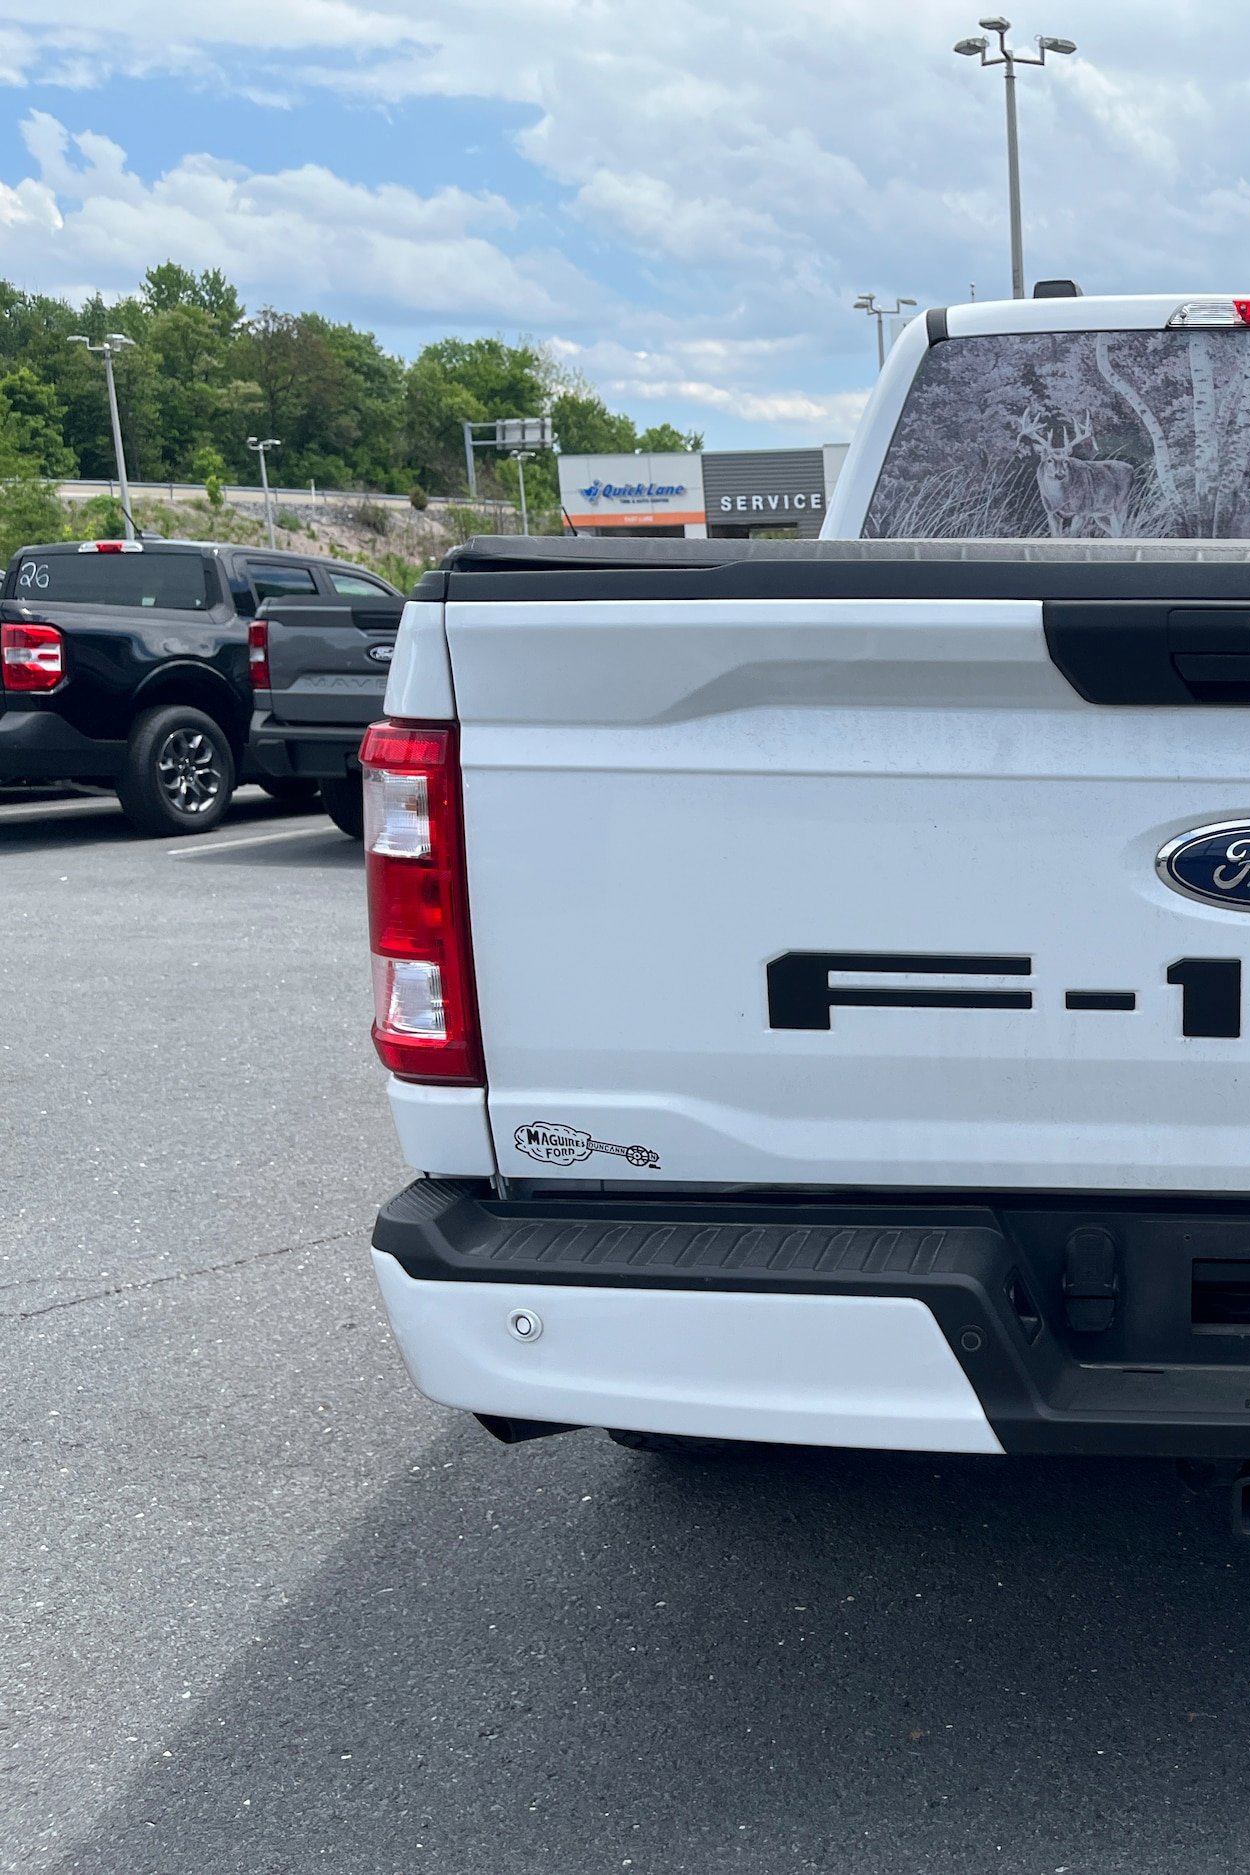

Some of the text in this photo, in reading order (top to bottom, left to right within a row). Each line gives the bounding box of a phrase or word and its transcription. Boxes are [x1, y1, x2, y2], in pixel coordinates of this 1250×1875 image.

[603, 483, 686, 499] Quick Lane
[720, 493, 822, 512] SERVICE
[20, 562, 49, 588] 26
[305, 677, 388, 689] MAVE
[546, 1148, 575, 1159] FORD
